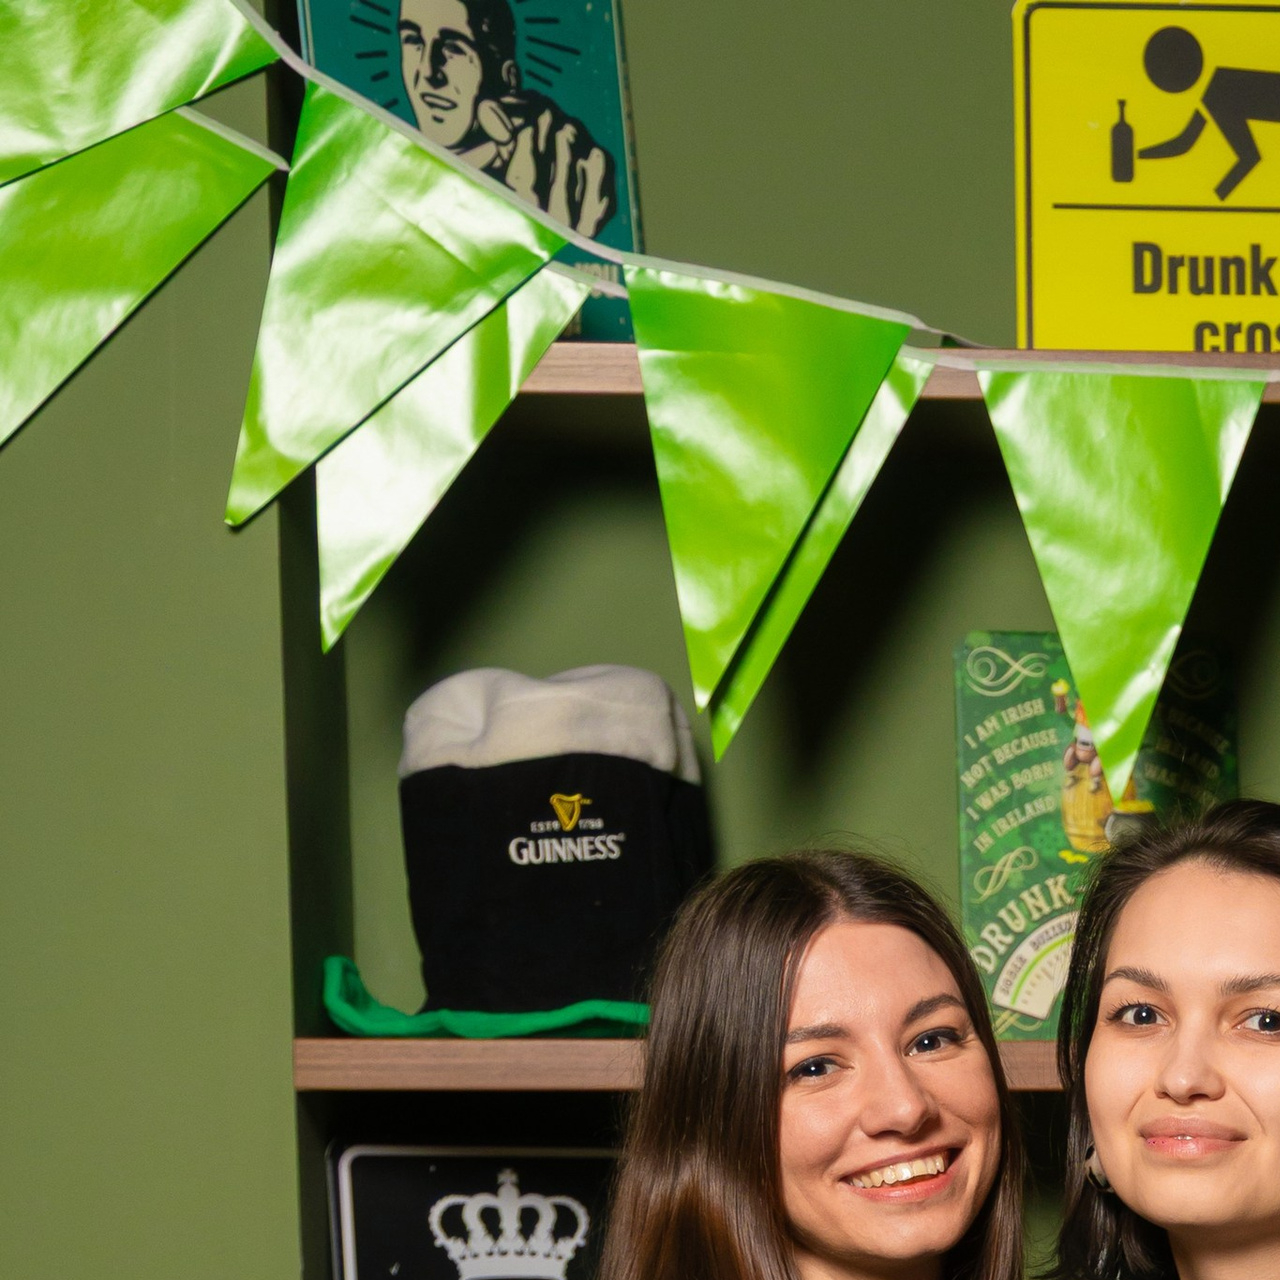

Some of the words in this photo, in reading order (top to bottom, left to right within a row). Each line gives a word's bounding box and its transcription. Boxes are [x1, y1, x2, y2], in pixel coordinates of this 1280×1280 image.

[1131, 241, 1279, 297] Drunk
[975, 715, 1001, 742] AM
[1001, 697, 1045, 726] IRISH
[992, 727, 1058, 765] BECAUSE
[974, 779, 1012, 811] WAS
[1010, 760, 1055, 790] BORN
[973, 831, 994, 853] IN
[991, 794, 1057, 838] IRELAND
[509, 836, 621, 865] GUINNESS
